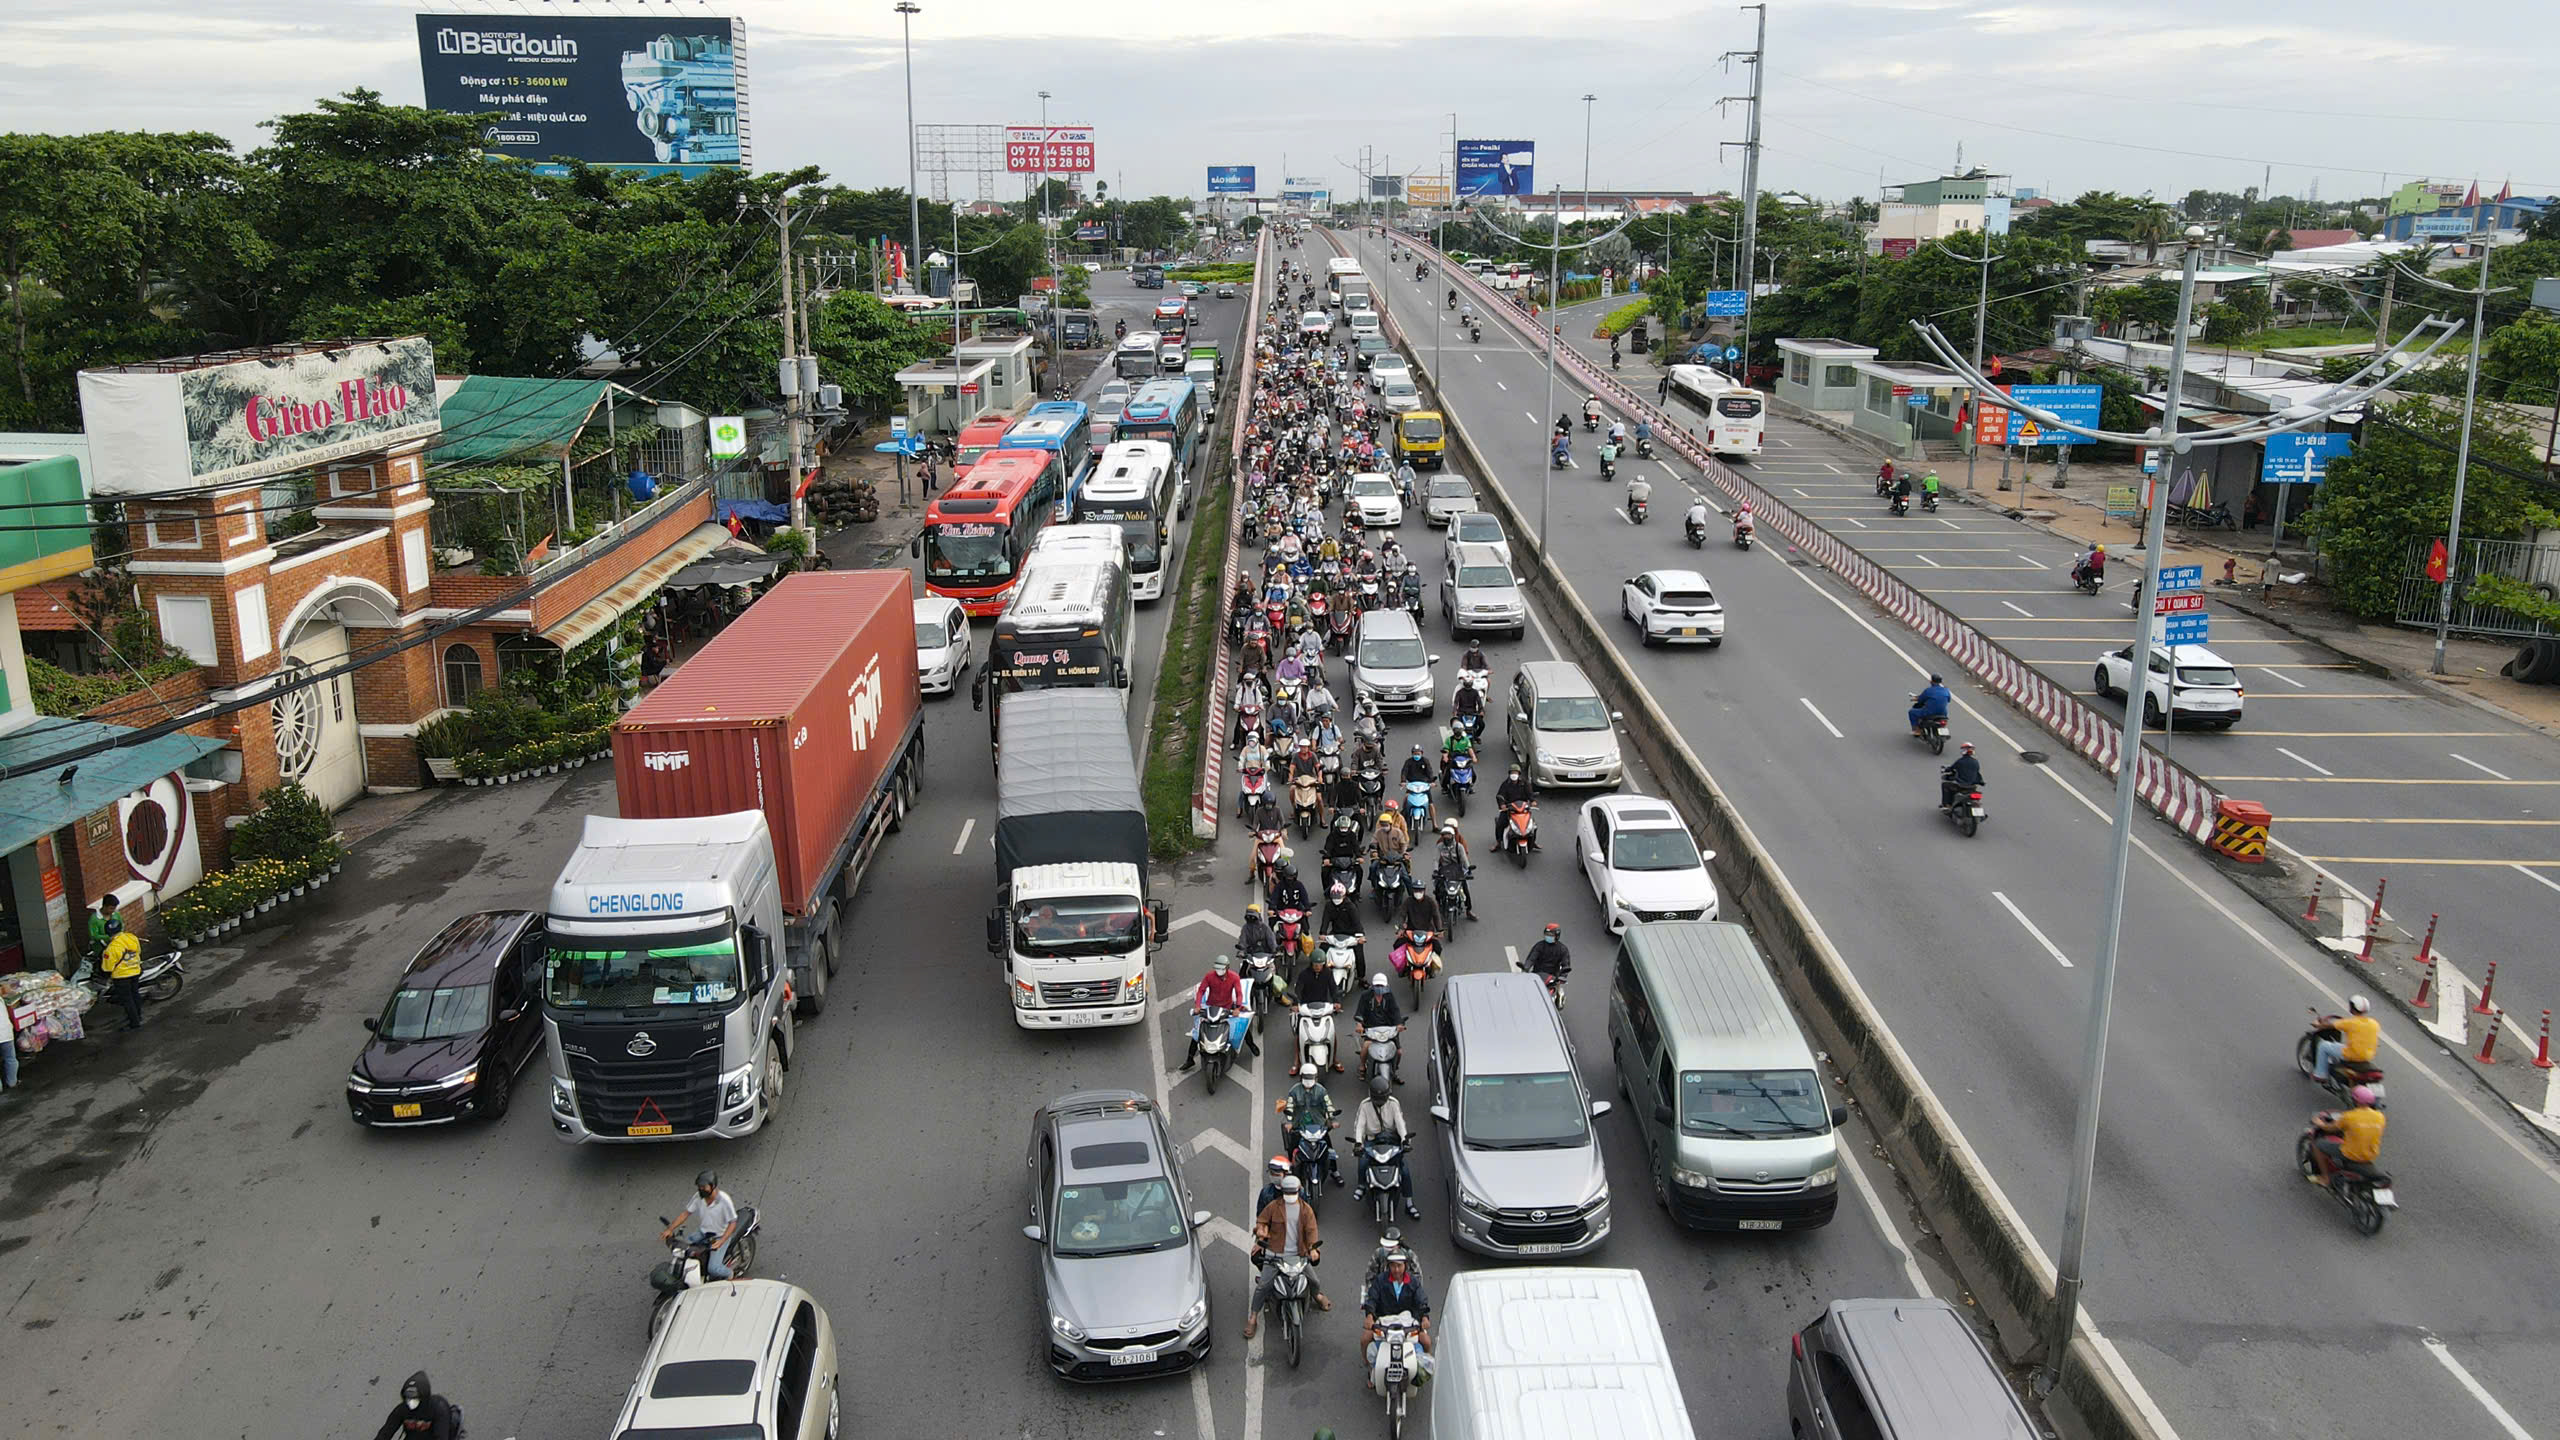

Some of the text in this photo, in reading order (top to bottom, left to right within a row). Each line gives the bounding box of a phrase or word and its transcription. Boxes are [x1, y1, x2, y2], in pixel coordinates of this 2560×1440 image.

[460, 32, 578, 56] Baudouin
[460, 75, 487, 87] Động
[488, 77, 500, 86] cơ
[507, 77, 519, 86] 15
[526, 77, 550, 86] 3600
[552, 77, 568, 86] kW
[480, 92, 548, 106] Máy phát điện
[527, 112, 548, 123] HIỆU
[549, 111, 568, 122] QUẢ
[569, 113, 587, 122] CAO
[496, 134, 536, 142] 1800 6323
[1011, 146, 1025, 156] 09
[1028, 146, 1040, 156] 77
[1060, 146, 1073, 156] 55
[1076, 146, 1090, 156] 88
[1011, 158, 1026, 168] 09
[1029, 158, 1040, 168] 13
[1059, 158, 1073, 168] 28
[1076, 158, 1090, 168] 80
[245, 374, 407, 443] Giao Hảo
[1083, 511, 1148, 521] Premium Noble
[938, 522, 961, 536] Kim
[1028, 668, 1041, 676] TÂY
[848, 664, 882, 752] HMM
[644, 752, 690, 771] HMM
[93, 821, 108, 838] APN
[589, 892, 683, 914] CHENGLONG
[695, 982, 726, 1002] 31361
